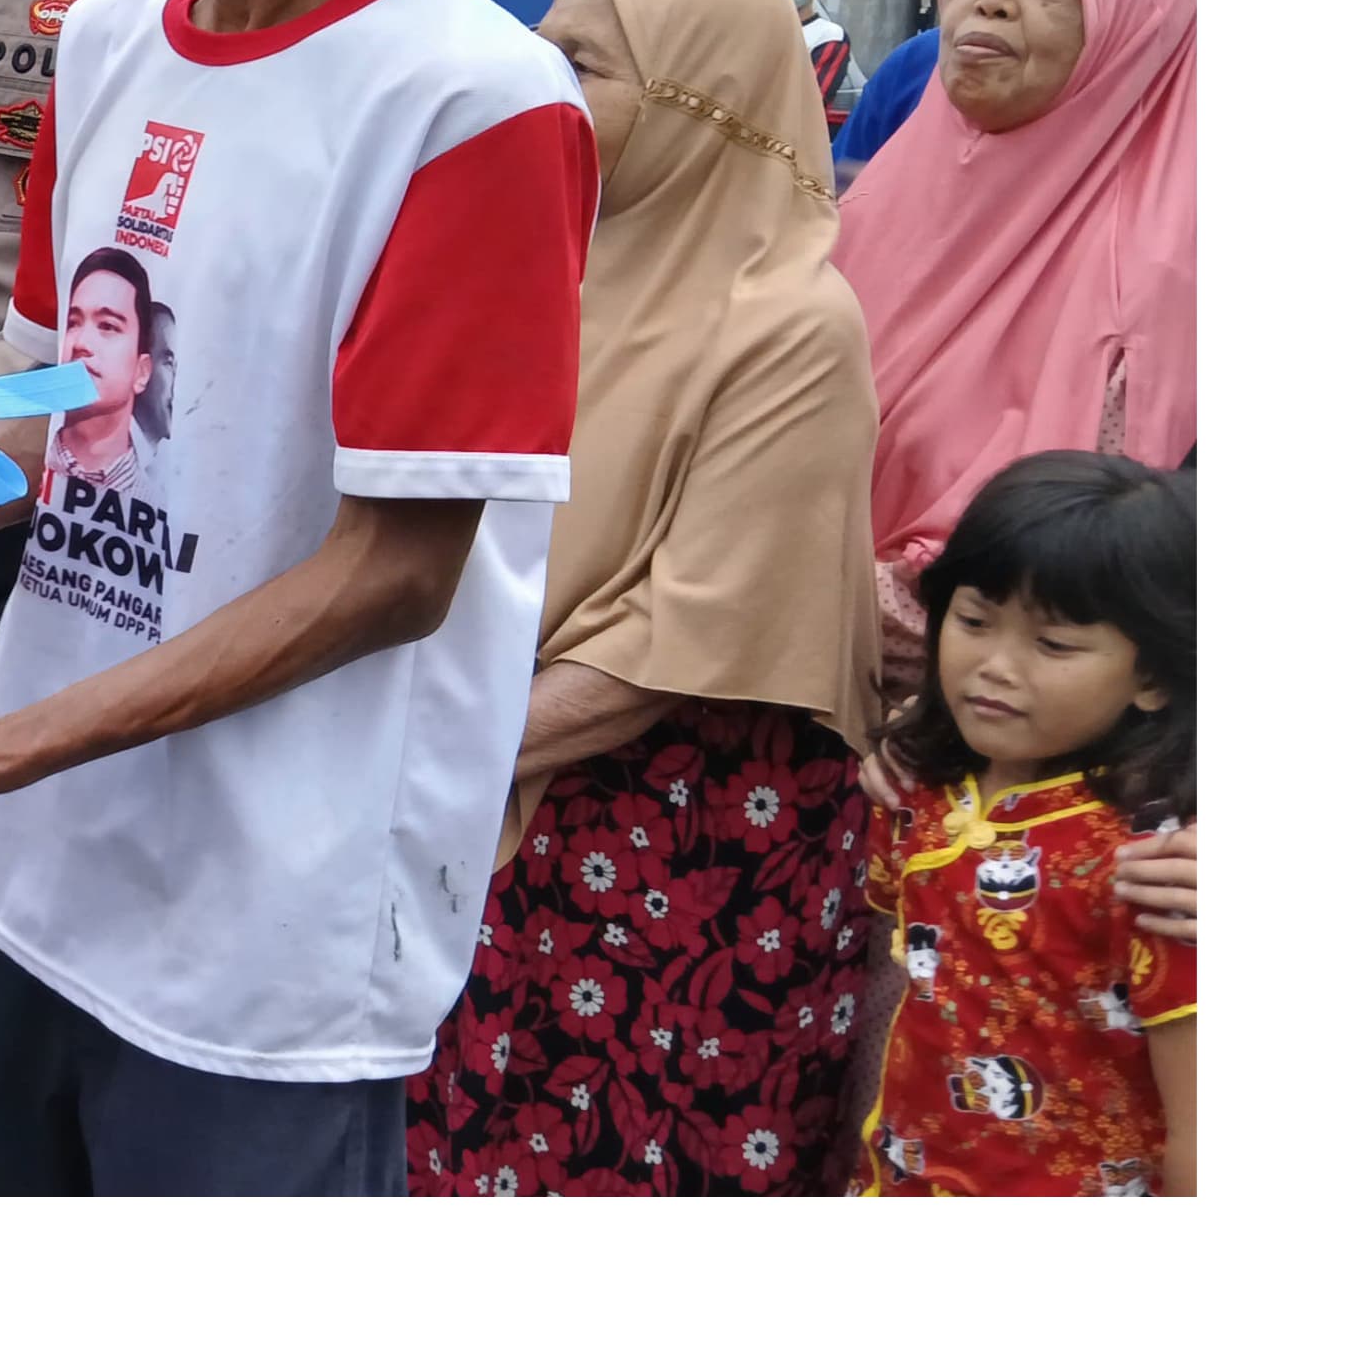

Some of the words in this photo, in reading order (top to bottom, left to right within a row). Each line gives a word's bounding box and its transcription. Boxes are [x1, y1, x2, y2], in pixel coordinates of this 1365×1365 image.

[29, 506, 164, 596] JOKOW
[94, 580, 162, 626] PANGAR
[114, 611, 145, 636] DPP
